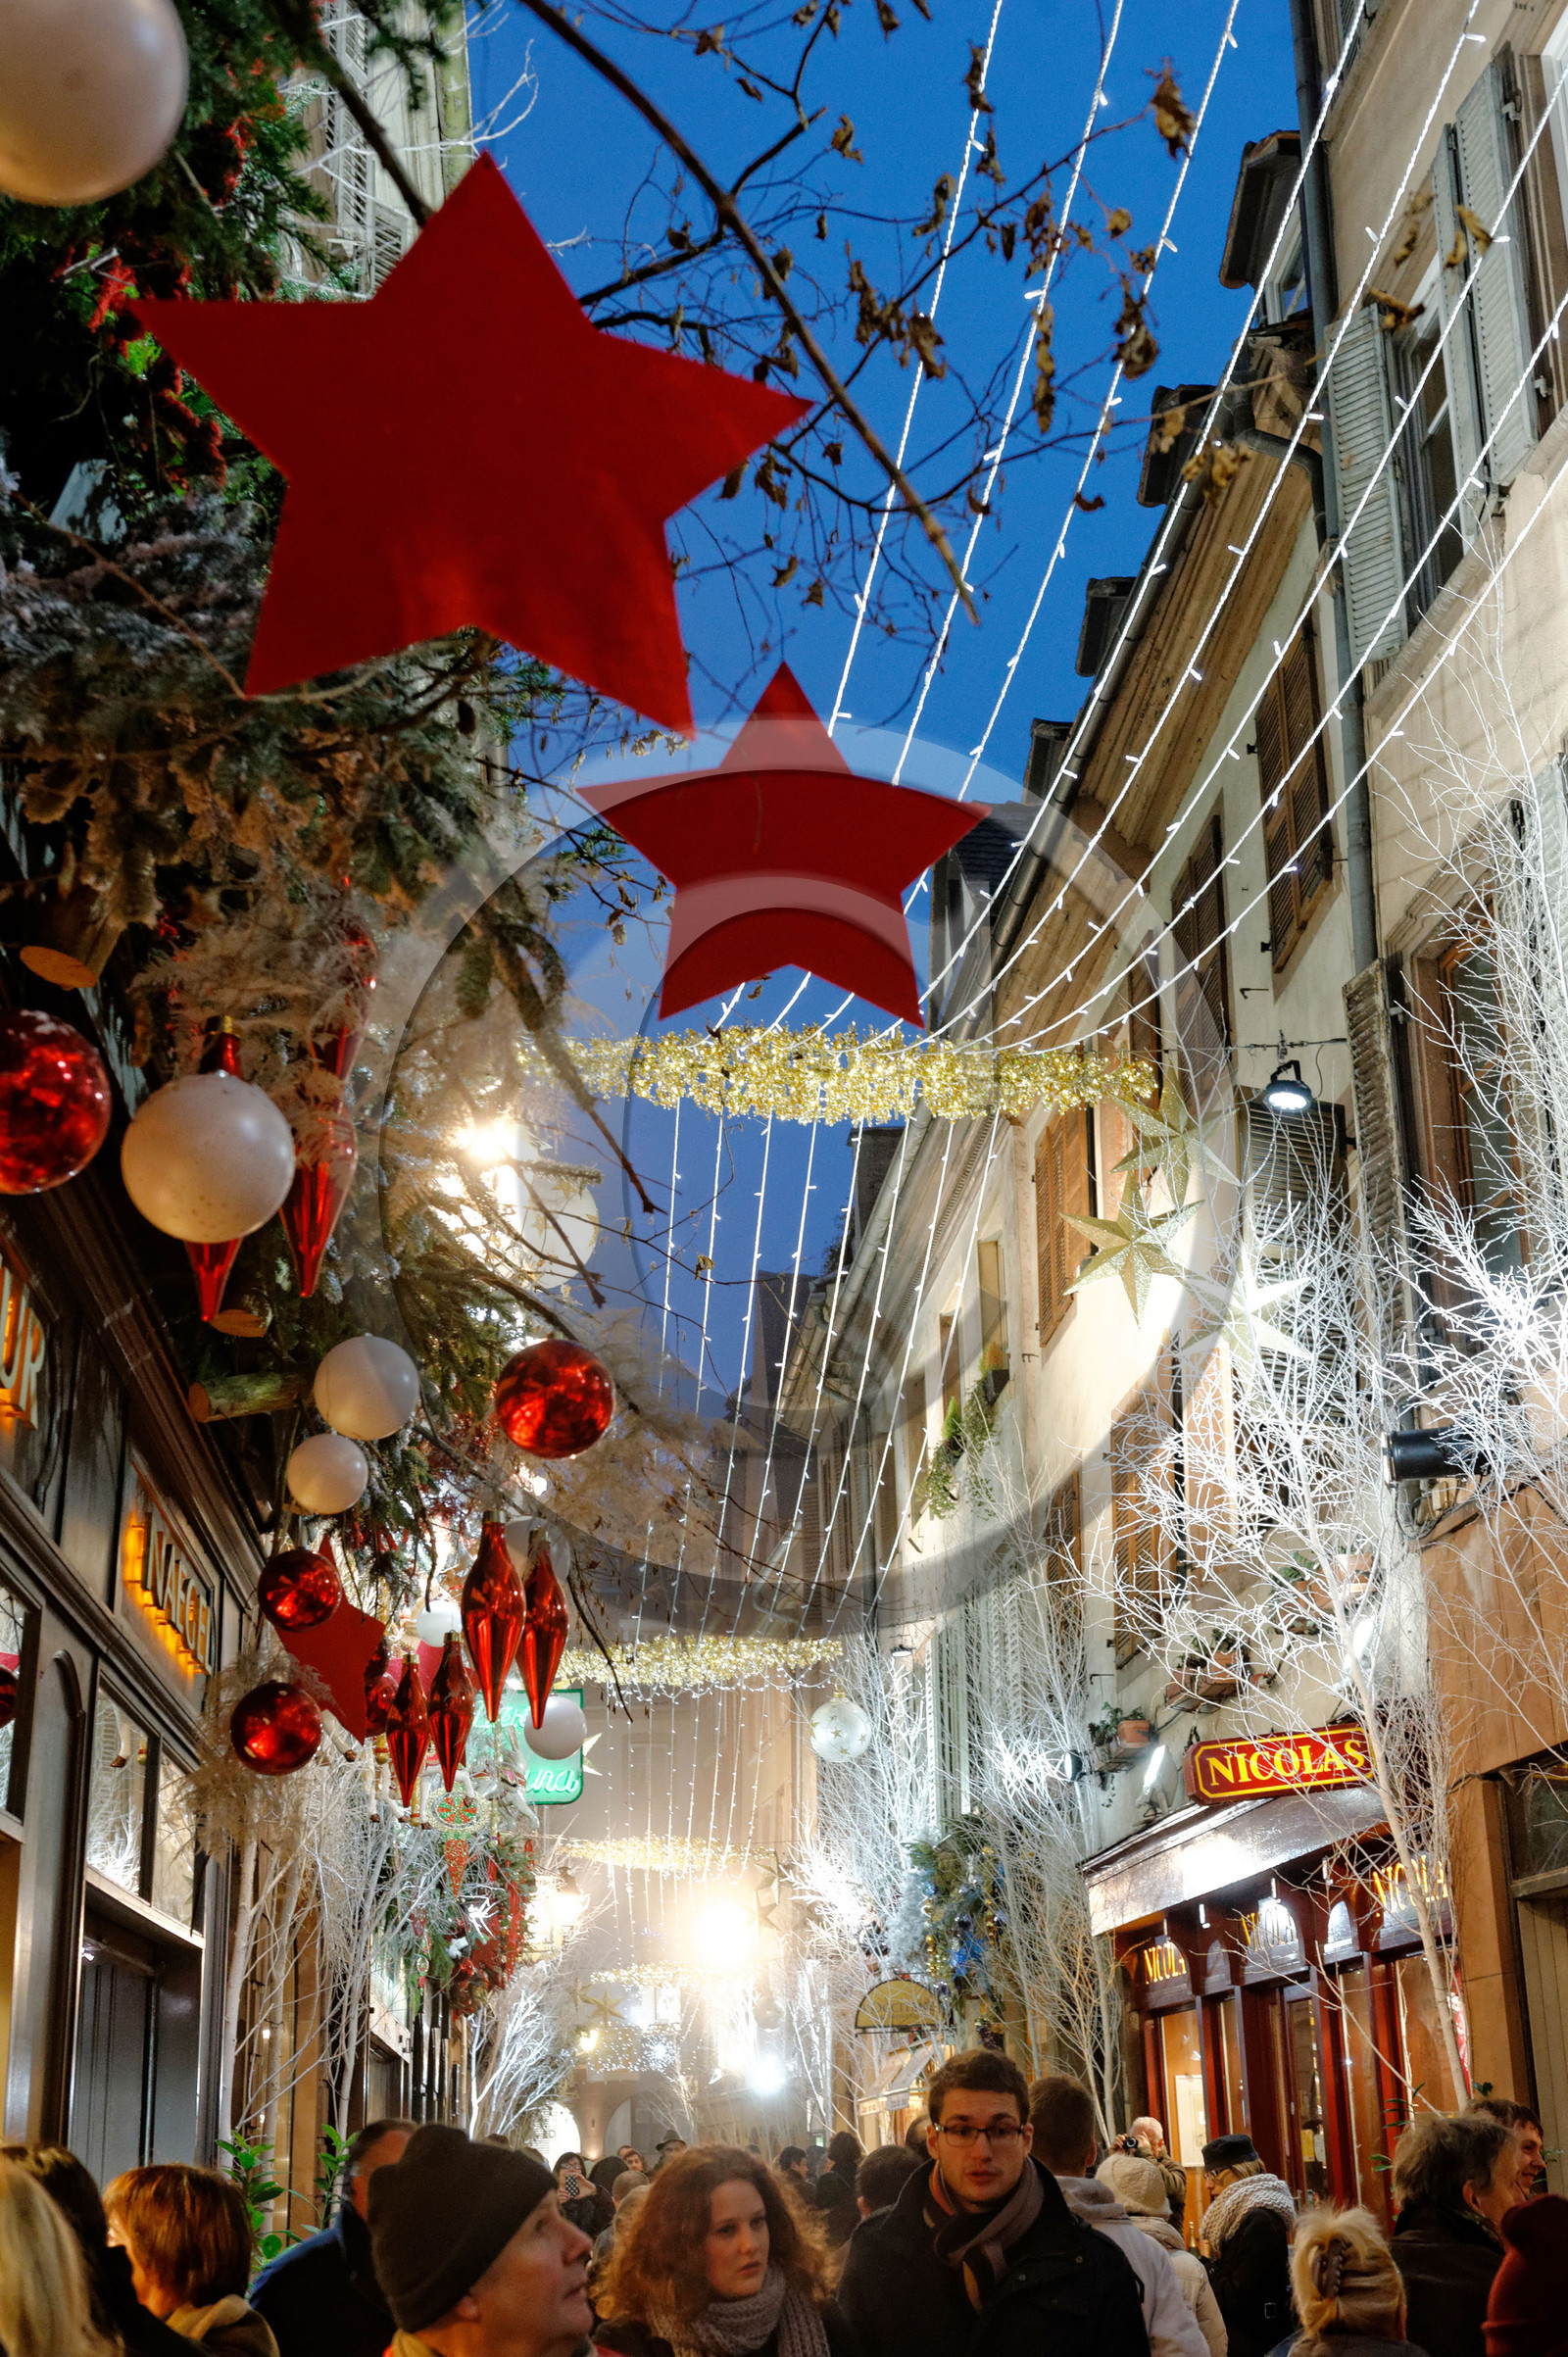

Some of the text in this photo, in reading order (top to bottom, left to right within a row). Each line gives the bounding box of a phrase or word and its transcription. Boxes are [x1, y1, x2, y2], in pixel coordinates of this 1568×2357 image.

[0, 1253, 45, 1430] UR
[147, 1512, 214, 1676] NAEGEL
[1206, 1740, 1365, 1787] NICOLAS
[1373, 1854, 1449, 1918] NICOLA
[1240, 1905, 1297, 1956] NICOLA
[1143, 1940, 1188, 1986] NICOLA
